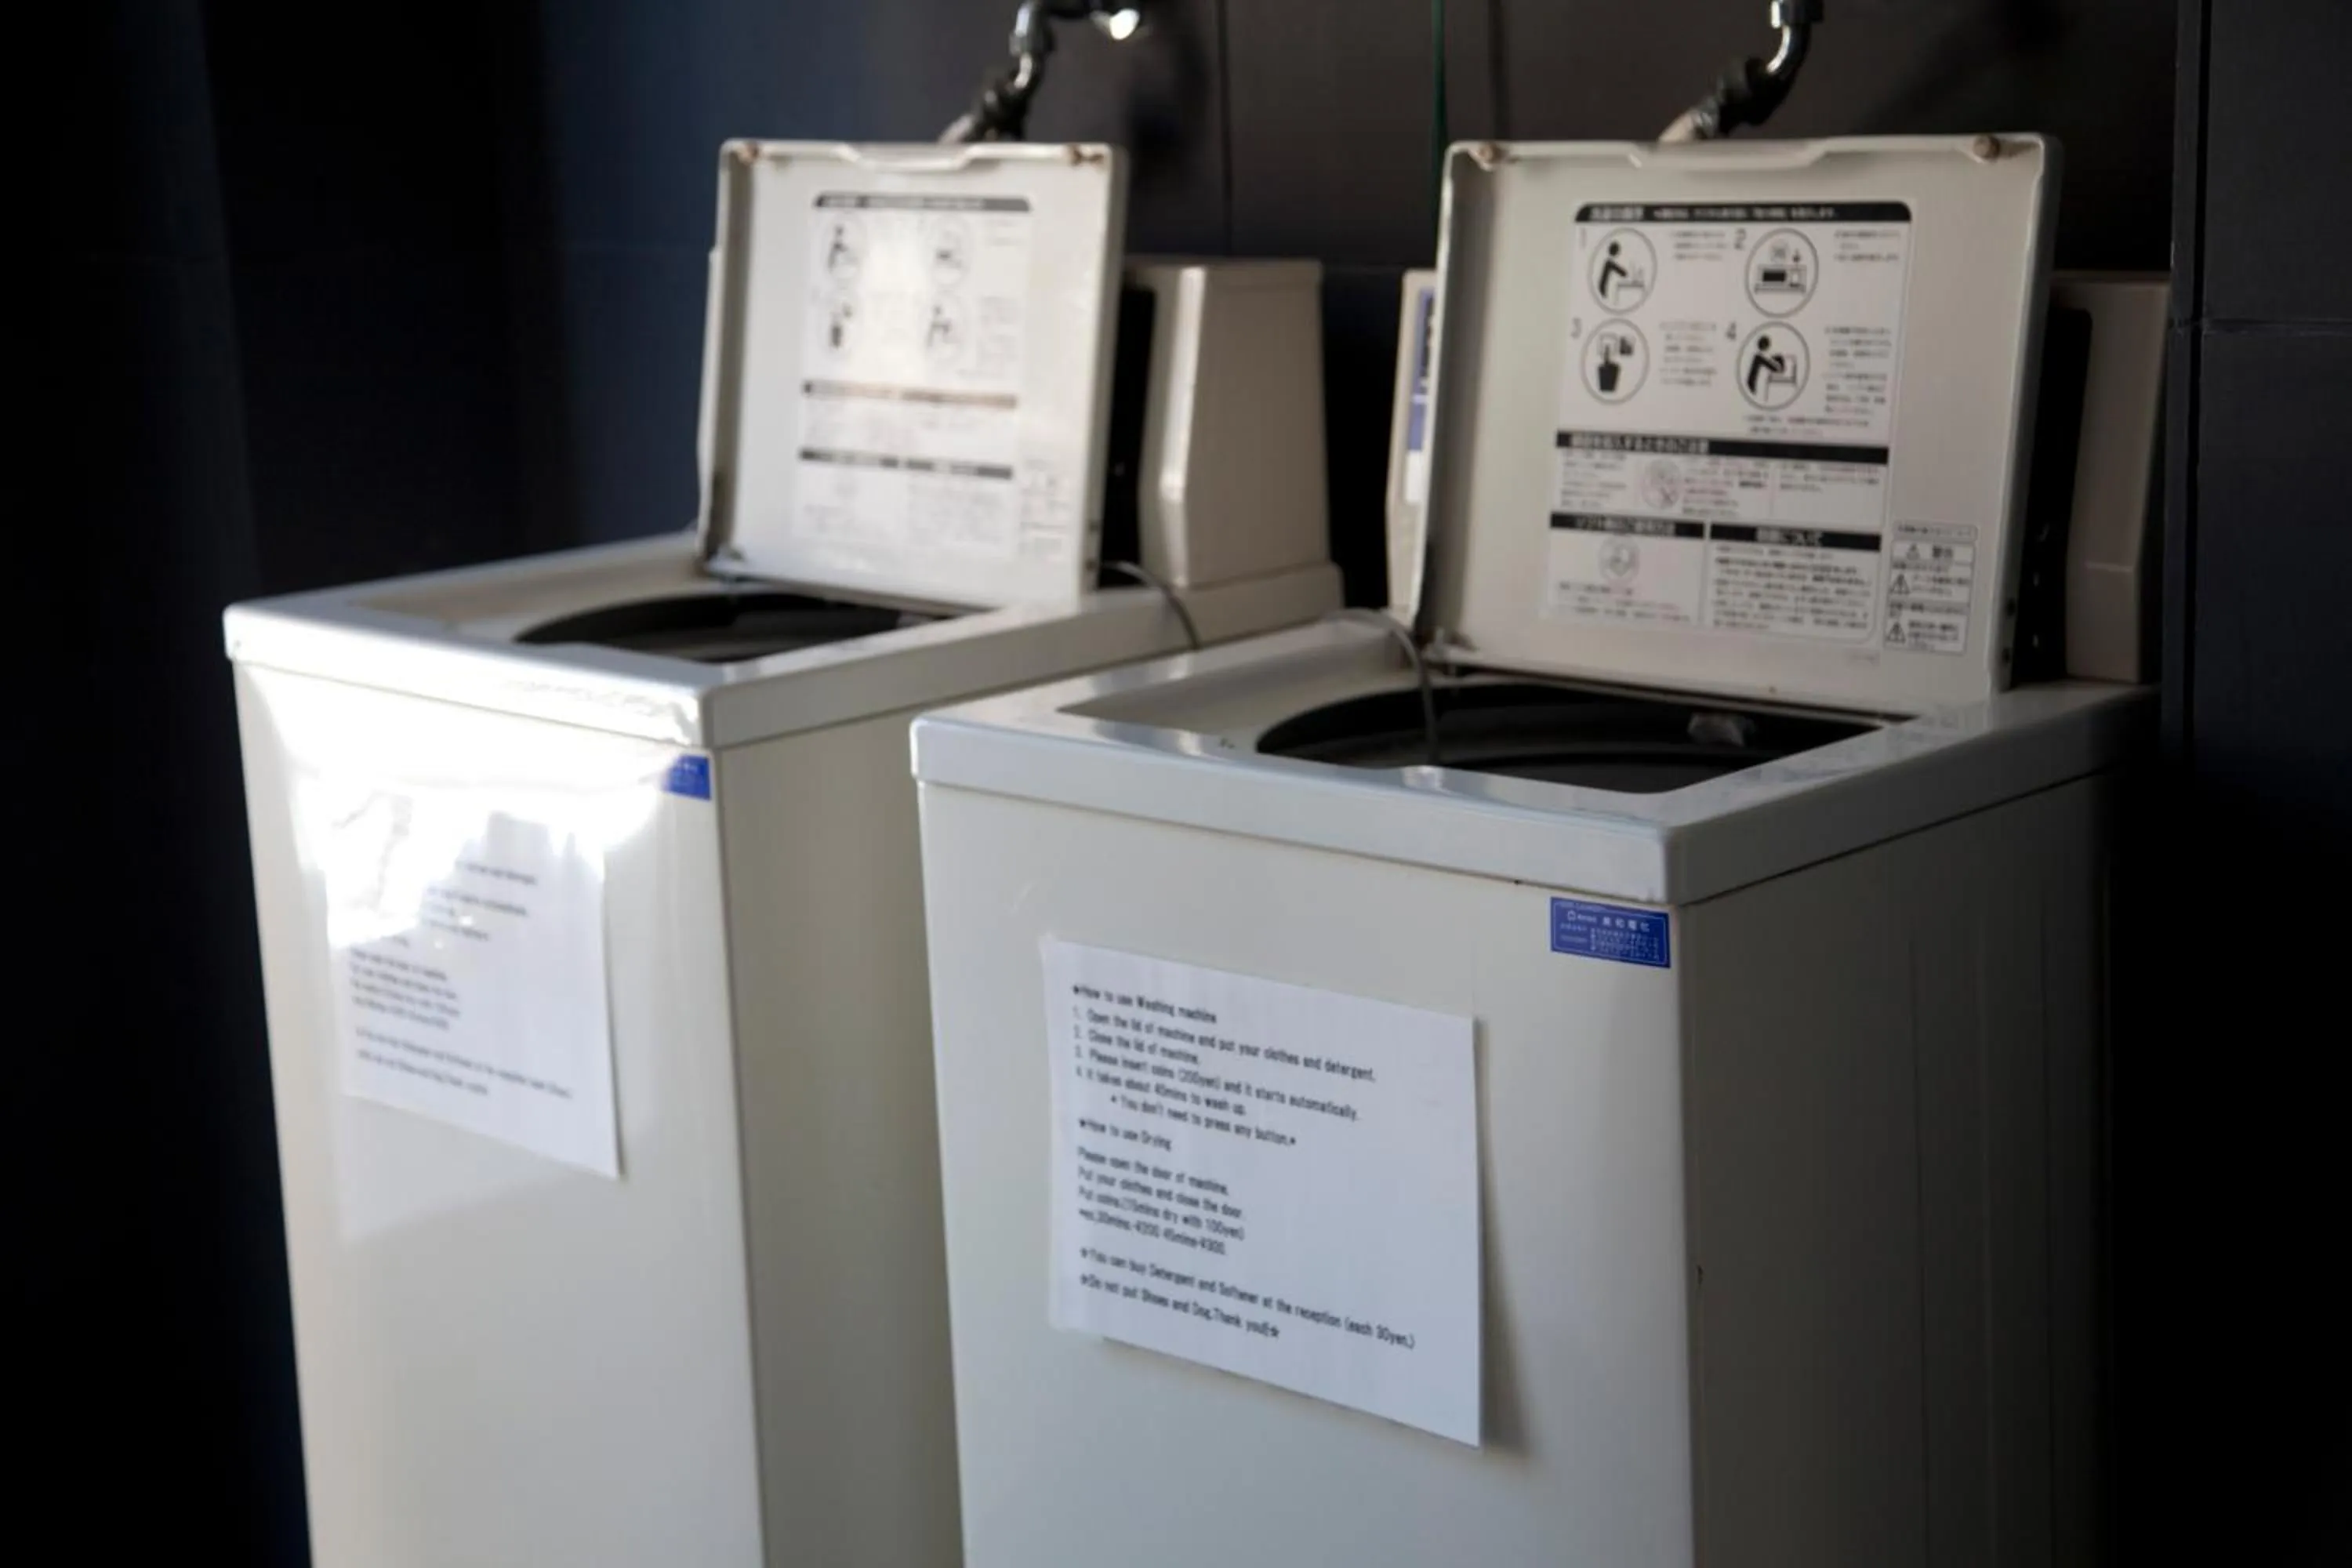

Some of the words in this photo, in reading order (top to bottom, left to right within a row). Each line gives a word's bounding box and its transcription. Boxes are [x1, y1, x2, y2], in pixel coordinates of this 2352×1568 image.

[1734, 228, 1746, 250] 2
[1570, 319, 1581, 339] 3
[1726, 323, 1737, 342] 4
[1117, 994, 1132, 1006] use
[1136, 995, 1174, 1017] Washing
[1087, 1008, 1109, 1025] Open
[1112, 1014, 1127, 1029] the
[1131, 1018, 1142, 1032] lid
[1145, 1022, 1153, 1034] of
[1158, 1025, 1194, 1044] machine
[1198, 1034, 1215, 1048] and
[1218, 1038, 1235, 1052] put
[1239, 1043, 1259, 1058] your
[1264, 1047, 1298, 1065] clothes
[1303, 1055, 1320, 1070] and
[1088, 1028, 1112, 1046] Close
[1116, 1034, 1129, 1049] the
[1134, 1037, 1144, 1053] lid
[1148, 1041, 1157, 1055] of
[1090, 1048, 1117, 1065] Please
[1121, 1057, 1147, 1072] insert
[1151, 1064, 1173, 1079] coins
[1178, 1068, 1221, 1090] (200yen)
[1225, 1080, 1241, 1094] and
[1245, 1083, 1251, 1097] it
[1256, 1087, 1286, 1105] starts
[1096, 1070, 1120, 1086] takes
[1125, 1077, 1149, 1093] about
[1191, 1092, 1200, 1104] to
[1205, 1097, 1229, 1111] wash
[1121, 1094, 1137, 1110] You
[1167, 1107, 1187, 1123] need
[1191, 1112, 1201, 1126] to
[1204, 1116, 1229, 1132] press
[1234, 1123, 1251, 1138] any
[1109, 1124, 1119, 1137] to
[1123, 1129, 1138, 1142] use
[1141, 1130, 1171, 1152] Drying
[1078, 1146, 1105, 1165] Please
[1109, 1156, 1129, 1171] open
[1134, 1160, 1148, 1174] the
[1152, 1165, 1171, 1181] door
[1175, 1171, 1184, 1184] of
[1078, 1165, 1093, 1181] Put
[1097, 1173, 1116, 1187] your
[1120, 1178, 1152, 1196] clothes
[1156, 1187, 1172, 1201] and
[1176, 1192, 1199, 1208] close
[1203, 1197, 1217, 1213] the
[1078, 1185, 1093, 1201] Put
[1163, 1207, 1178, 1224] dry
[1182, 1214, 1201, 1228] with
[1104, 1280, 1119, 1294] not
[1123, 1285, 1137, 1299] put
[1142, 1287, 1168, 1308] Shoes
[1172, 1298, 1189, 1313] and
[1110, 1255, 1126, 1269] can
[1129, 1260, 1145, 1275] buy
[1149, 1263, 1193, 1287] Detergent
[1198, 1279, 1216, 1293] and
[1219, 1282, 1258, 1304] Softener
[1263, 1296, 1272, 1308] at
[1276, 1298, 1291, 1314] the
[1295, 1305, 1341, 1327] reception
[1345, 1316, 1373, 1336] (each
